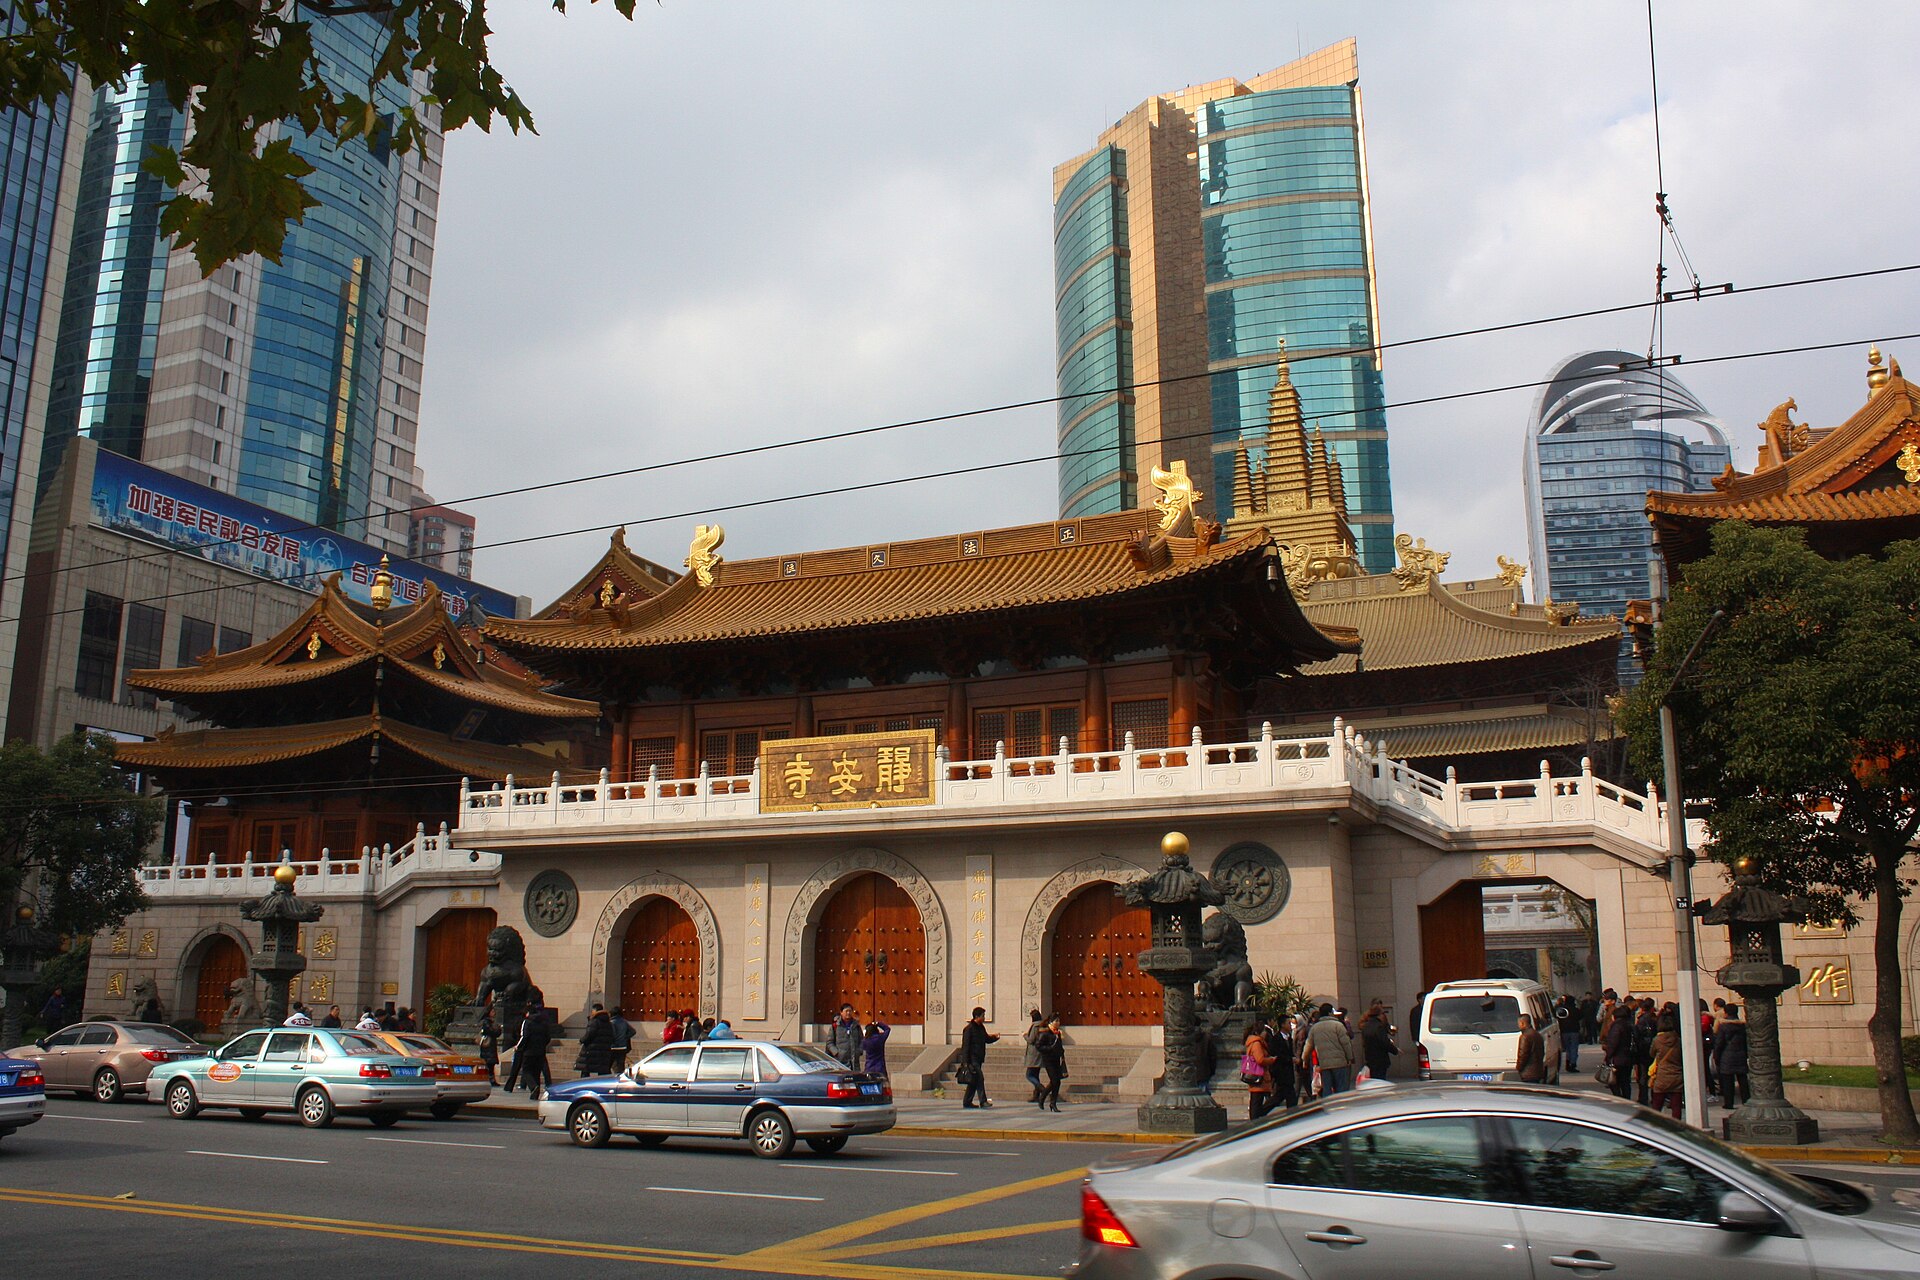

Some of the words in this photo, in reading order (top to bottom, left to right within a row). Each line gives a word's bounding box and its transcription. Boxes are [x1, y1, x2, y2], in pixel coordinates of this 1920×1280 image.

[127, 483, 301, 564] 加强军民融合发展
[1365, 950, 1388, 960] 1686
[1801, 963, 1848, 998] 作
